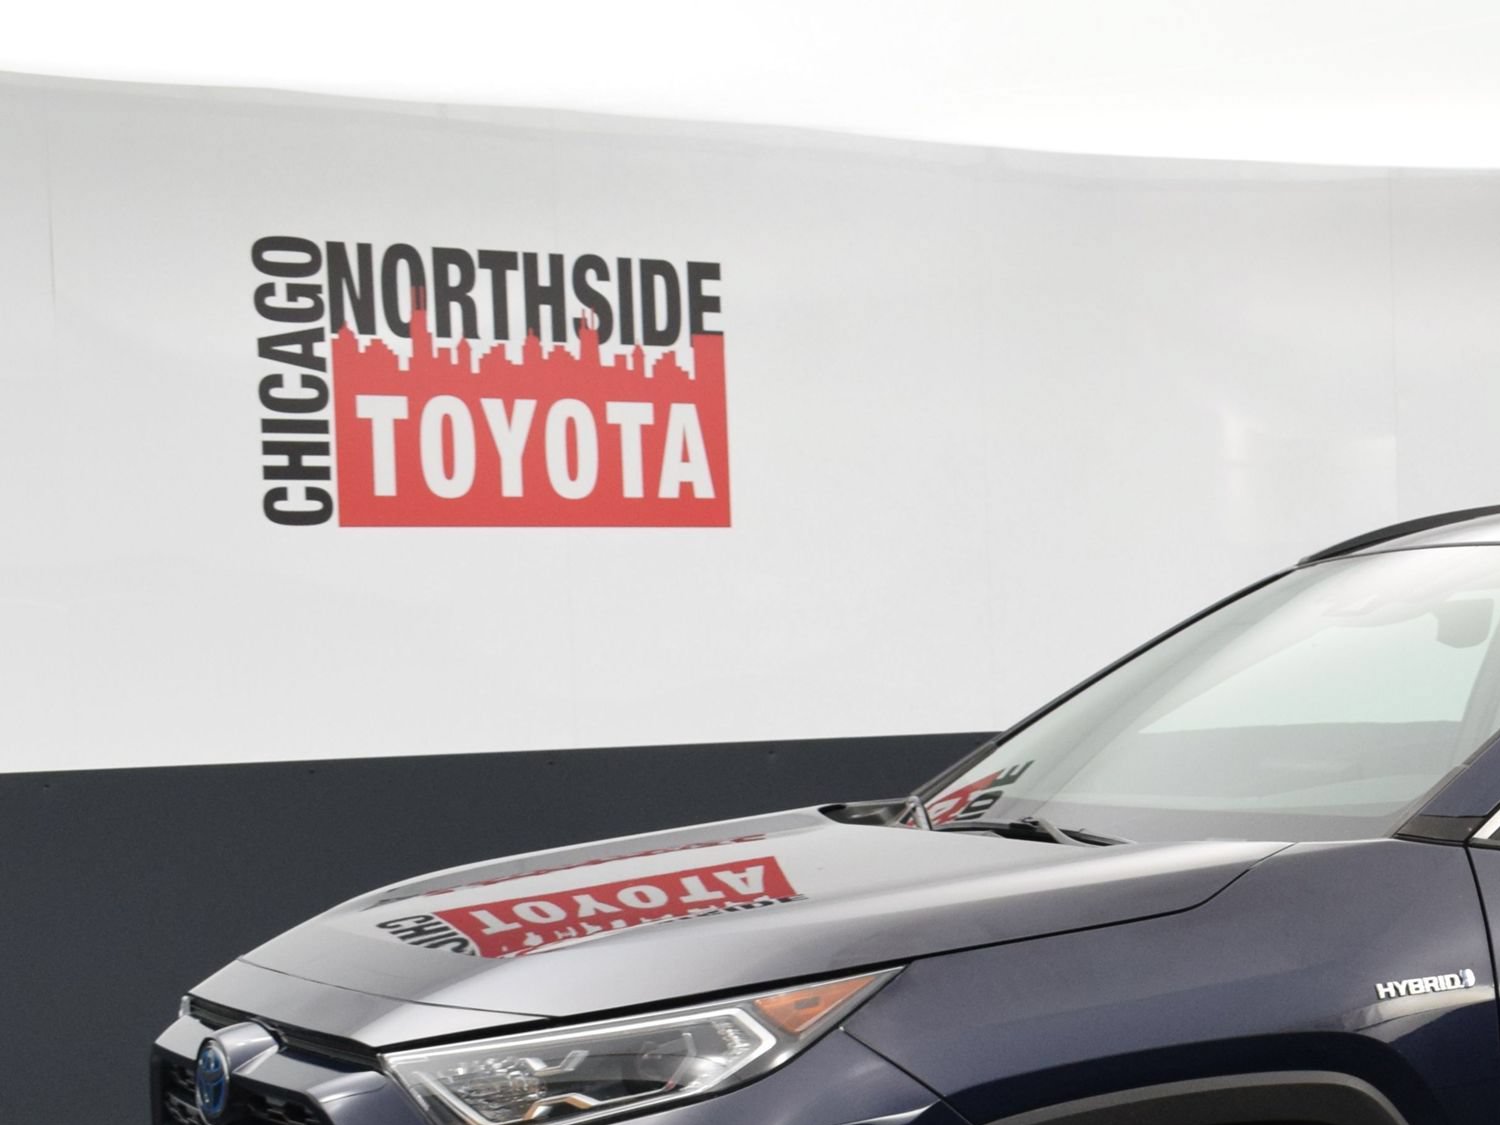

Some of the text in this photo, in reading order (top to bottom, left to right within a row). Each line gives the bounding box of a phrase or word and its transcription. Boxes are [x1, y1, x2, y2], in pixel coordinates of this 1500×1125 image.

[325, 240, 722, 348] NORTHSIDE
[251, 235, 334, 527] CHICAGO
[355, 394, 716, 500] TOYOTA
[1375, 973, 1464, 1000] HYBRID
